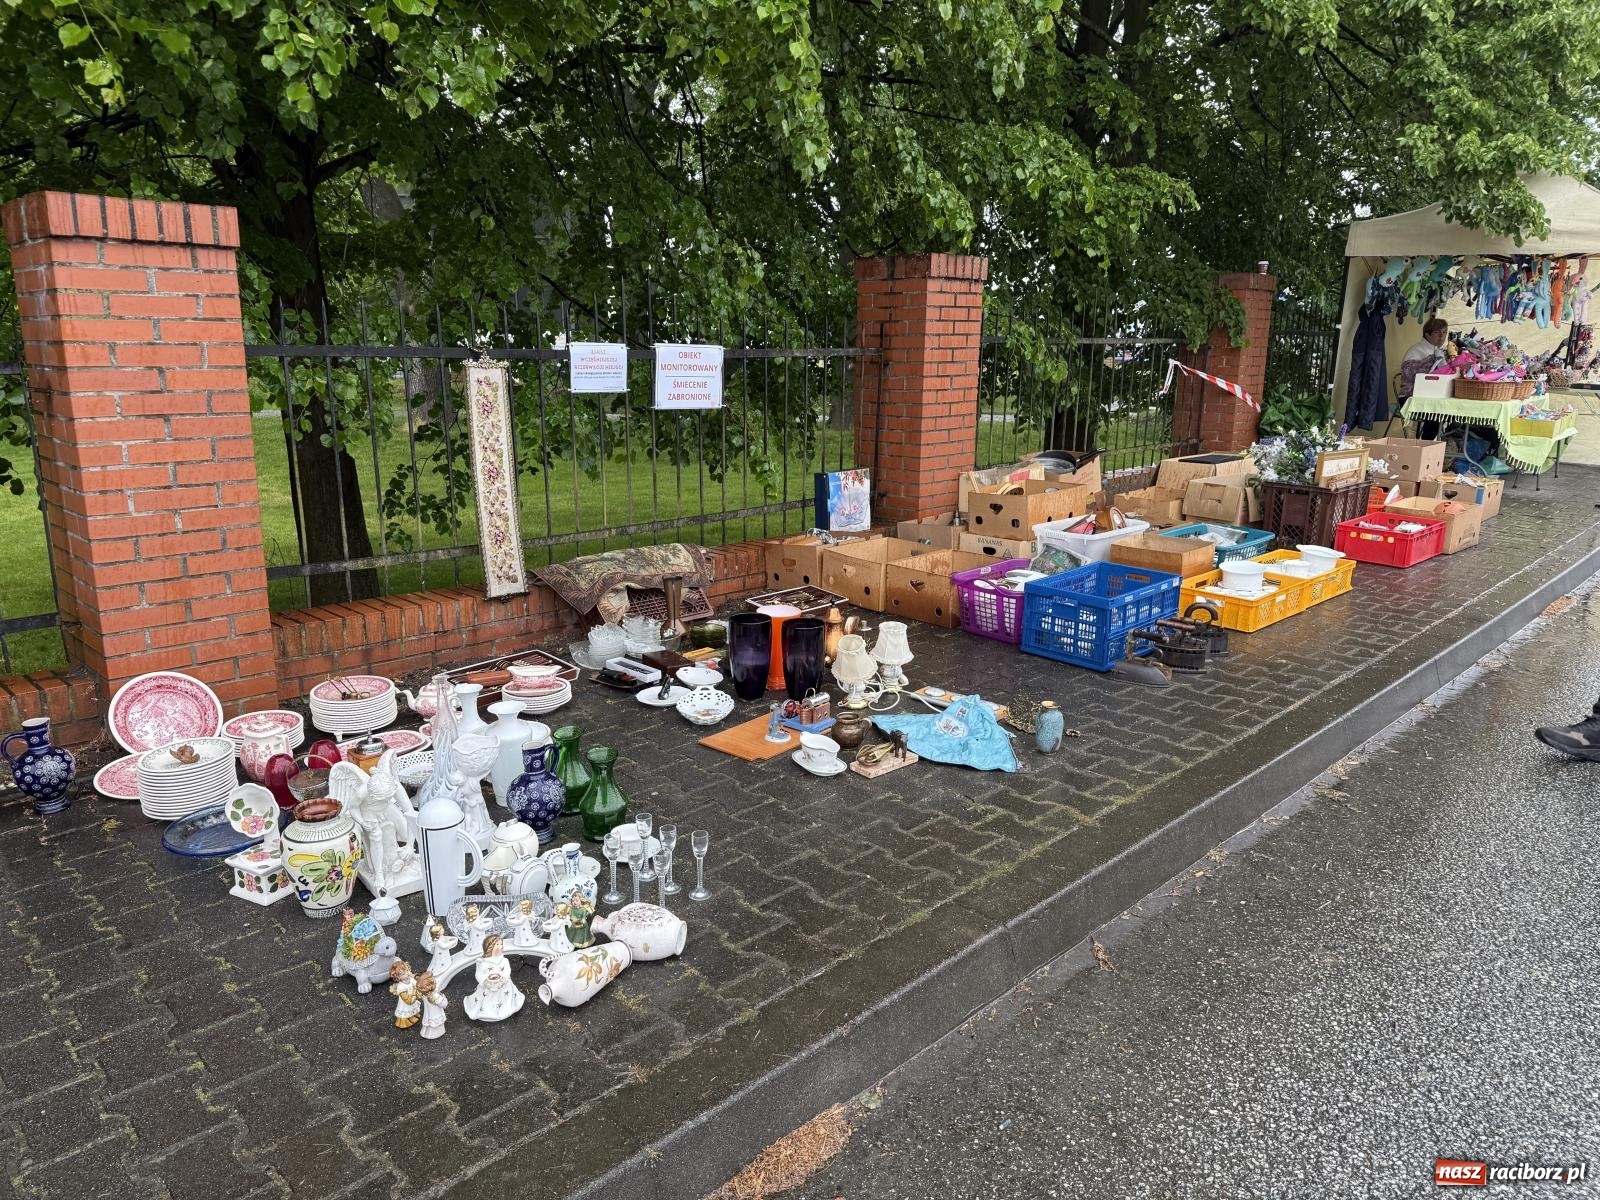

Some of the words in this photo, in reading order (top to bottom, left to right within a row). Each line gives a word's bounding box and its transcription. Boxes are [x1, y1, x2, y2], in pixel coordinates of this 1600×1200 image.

[678, 351, 702, 359] OBIEKT
[660, 363, 718, 372] MONITOROWANY
[672, 379, 708, 389] ŚMIECENIE
[667, 393, 712, 401] ZABRONIONE
[977, 538, 1003, 547] BANANAS
